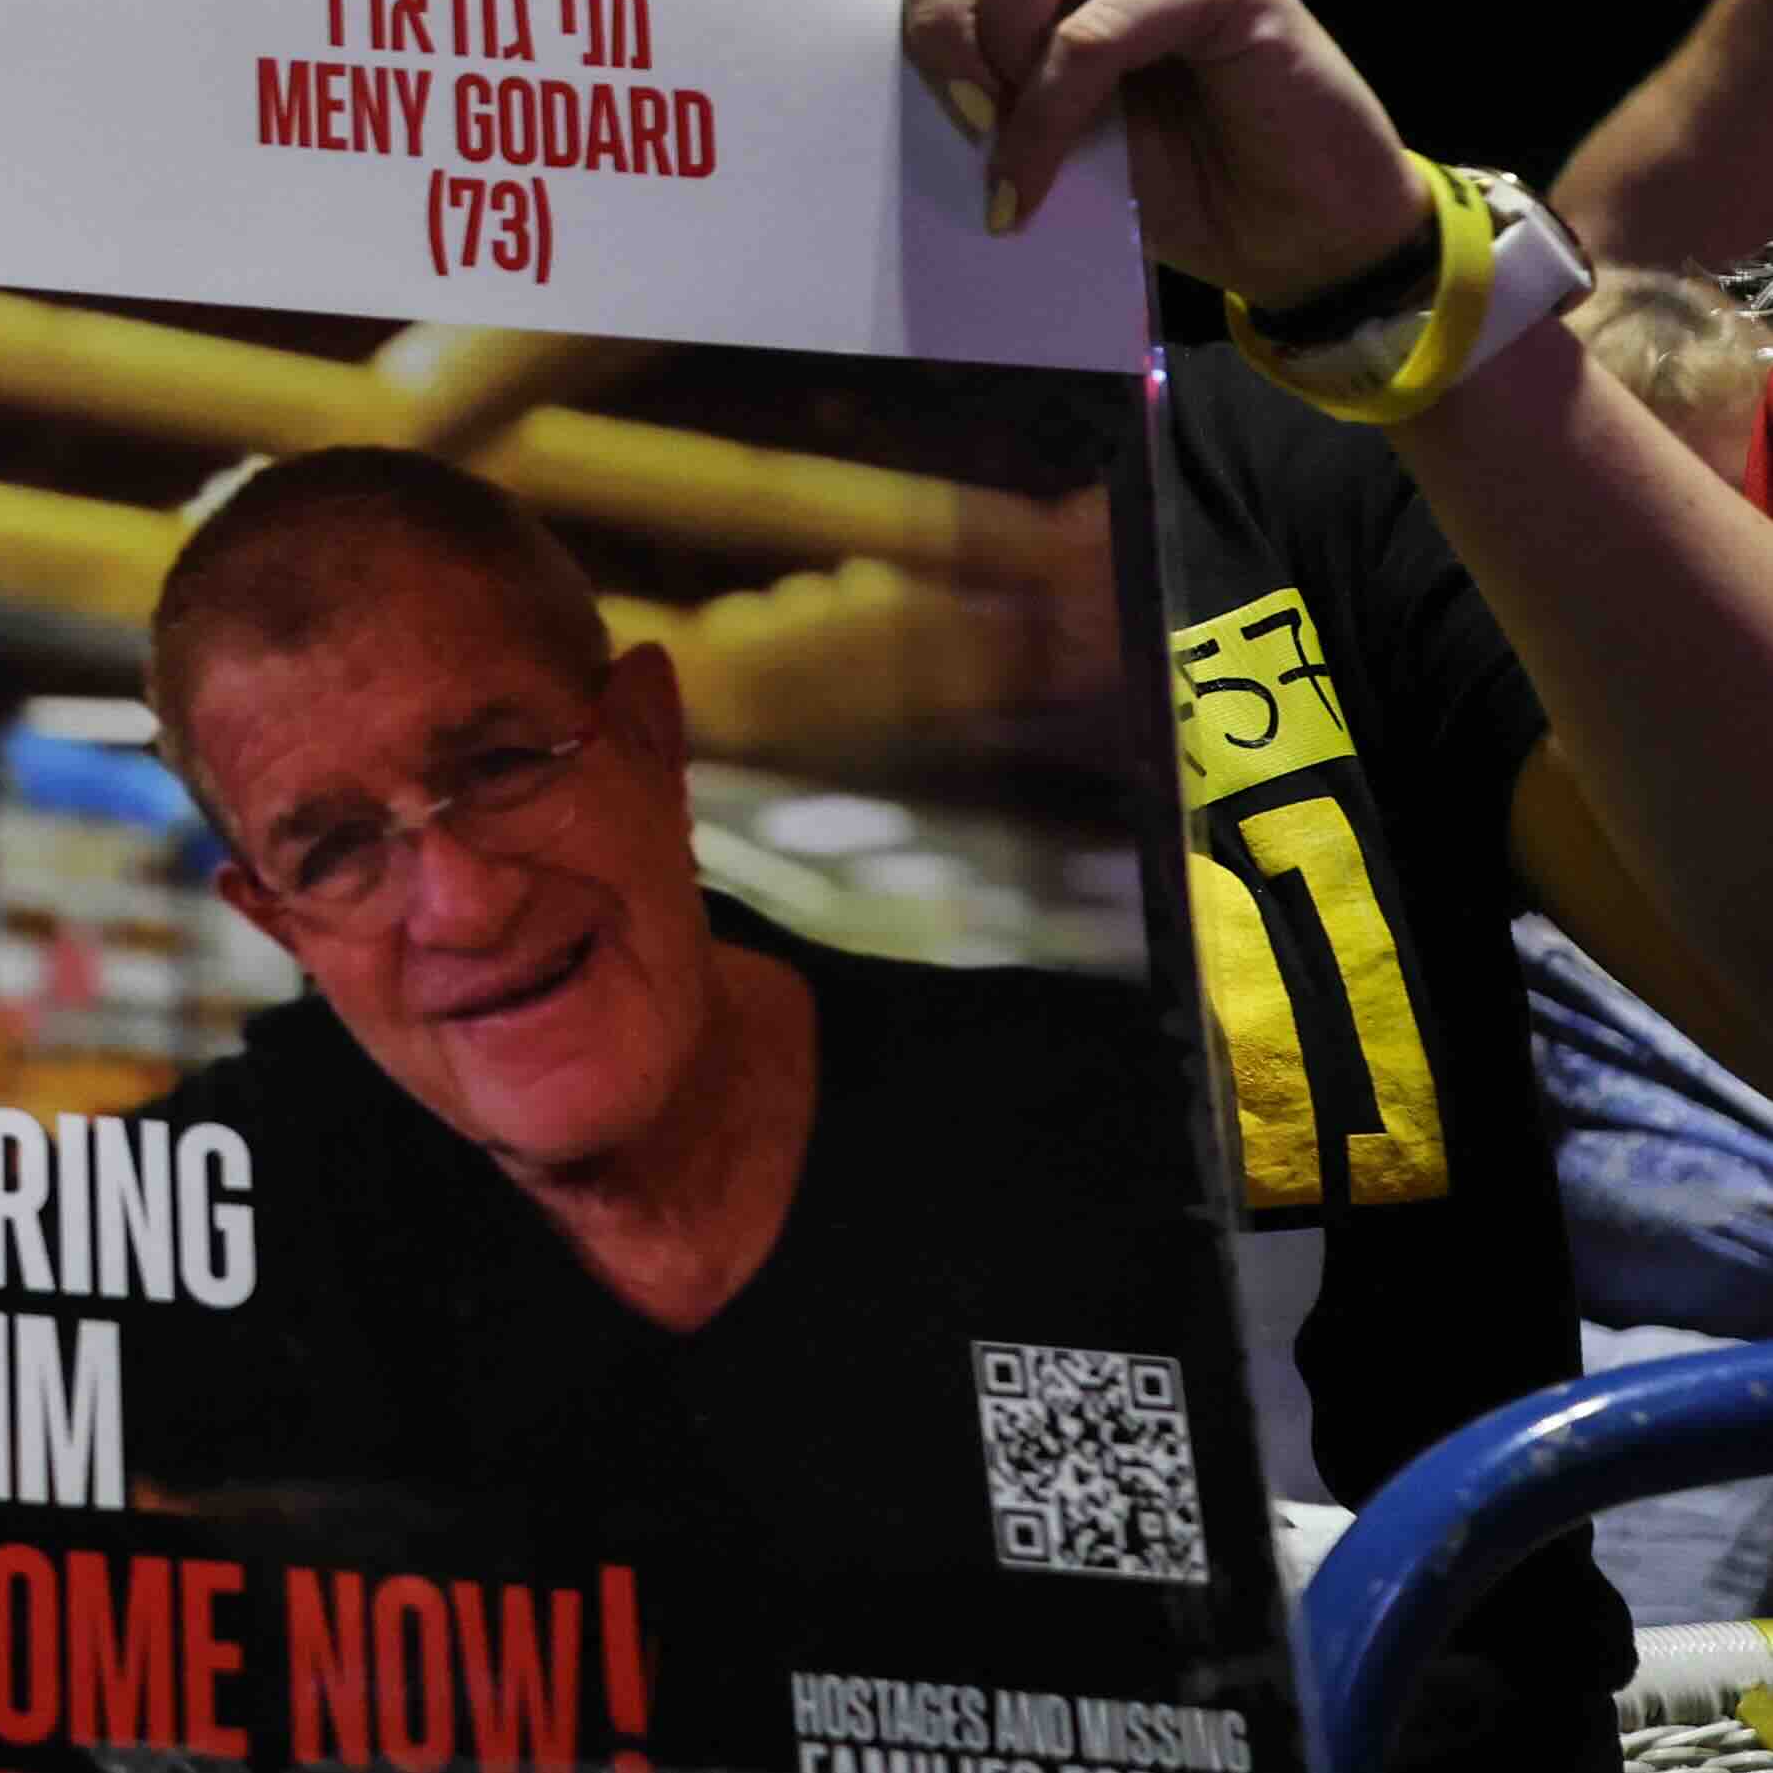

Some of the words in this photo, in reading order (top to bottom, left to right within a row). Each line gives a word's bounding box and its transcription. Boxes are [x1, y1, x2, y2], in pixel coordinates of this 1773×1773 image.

[258, 56, 433, 159] MENY
[453, 71, 718, 180] GODARD
[426, 168, 554, 286] (73)
[285, 1564, 649, 1773] NOW!
[791, 1671, 991, 1754] HOSTAGES
[995, 1688, 1076, 1760] AND
[1077, 1696, 1252, 1773] MISSING
